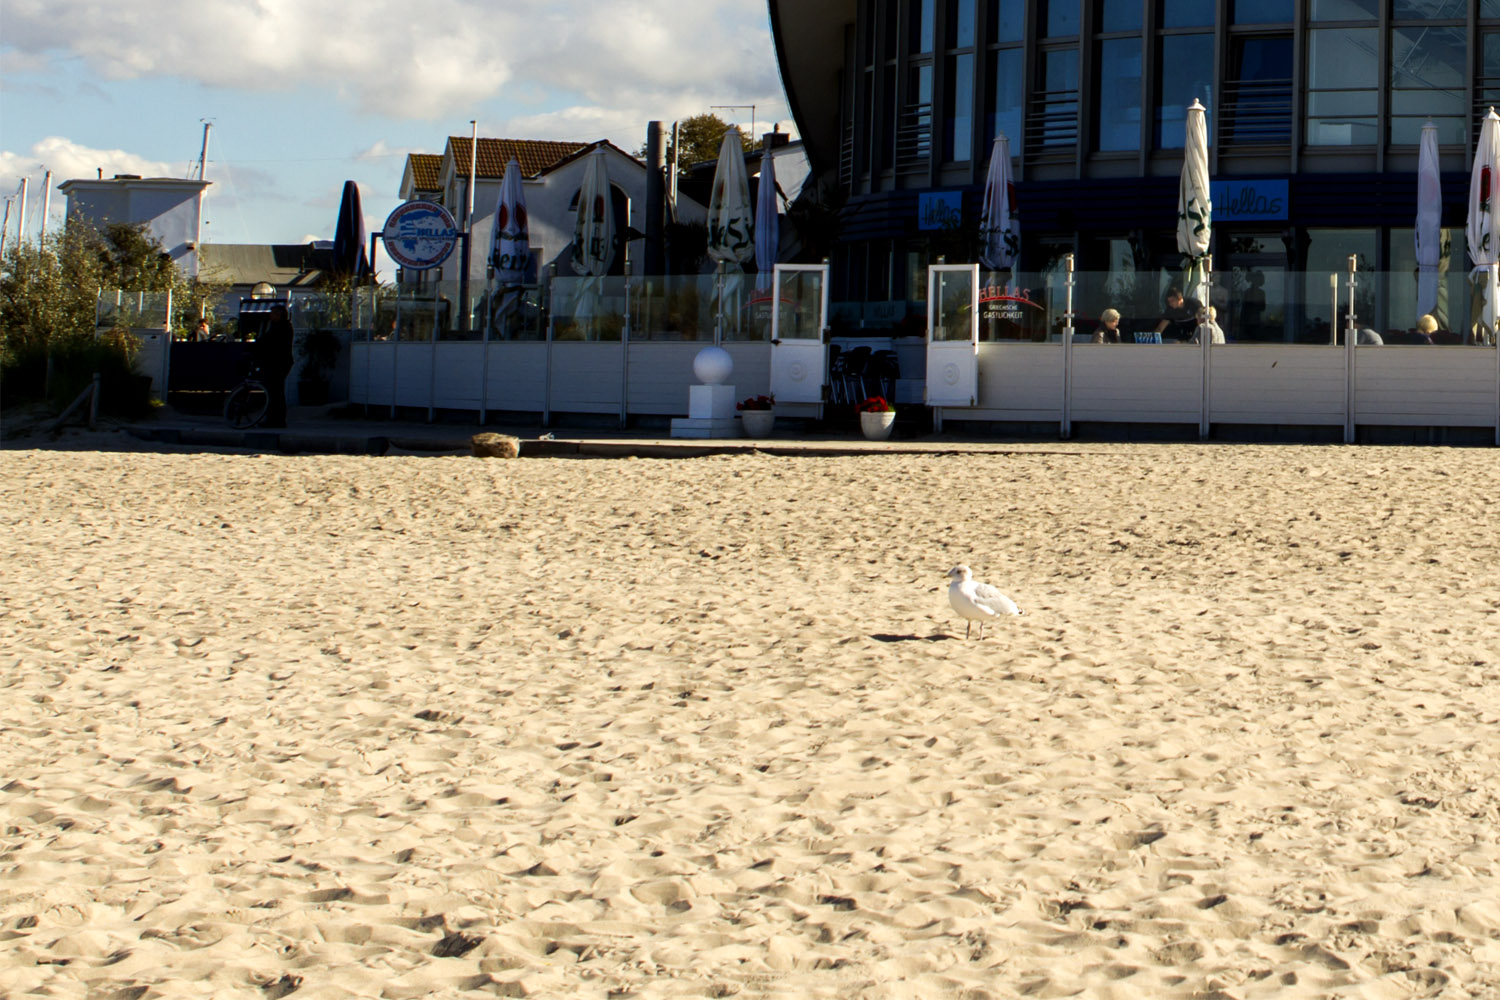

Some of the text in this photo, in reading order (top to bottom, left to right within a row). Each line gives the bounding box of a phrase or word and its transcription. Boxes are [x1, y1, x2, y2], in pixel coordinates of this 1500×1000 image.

[1213, 184, 1283, 217] Hellas
[978, 286, 1031, 300] HELLAS
[983, 310, 1023, 319] GASTLICHKEIT
